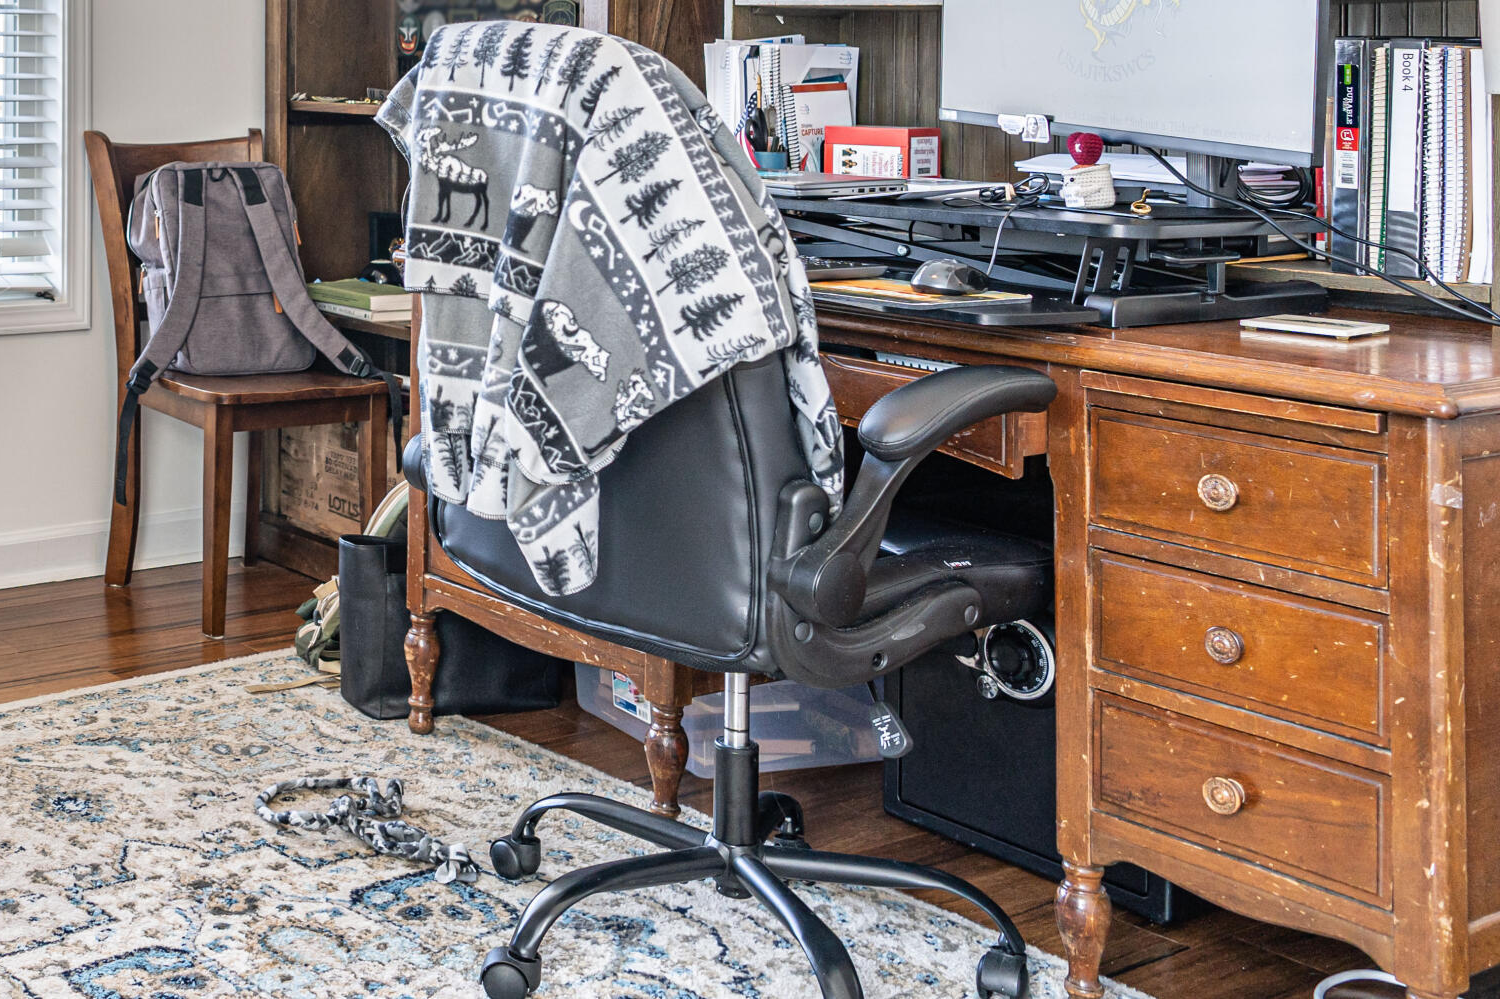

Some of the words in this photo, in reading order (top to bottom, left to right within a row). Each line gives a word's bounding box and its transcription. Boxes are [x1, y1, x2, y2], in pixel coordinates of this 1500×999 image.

[1402, 53, 1414, 81] Book
[801, 128, 823, 136] CAPTURE
[329, 494, 346, 512] LOT
